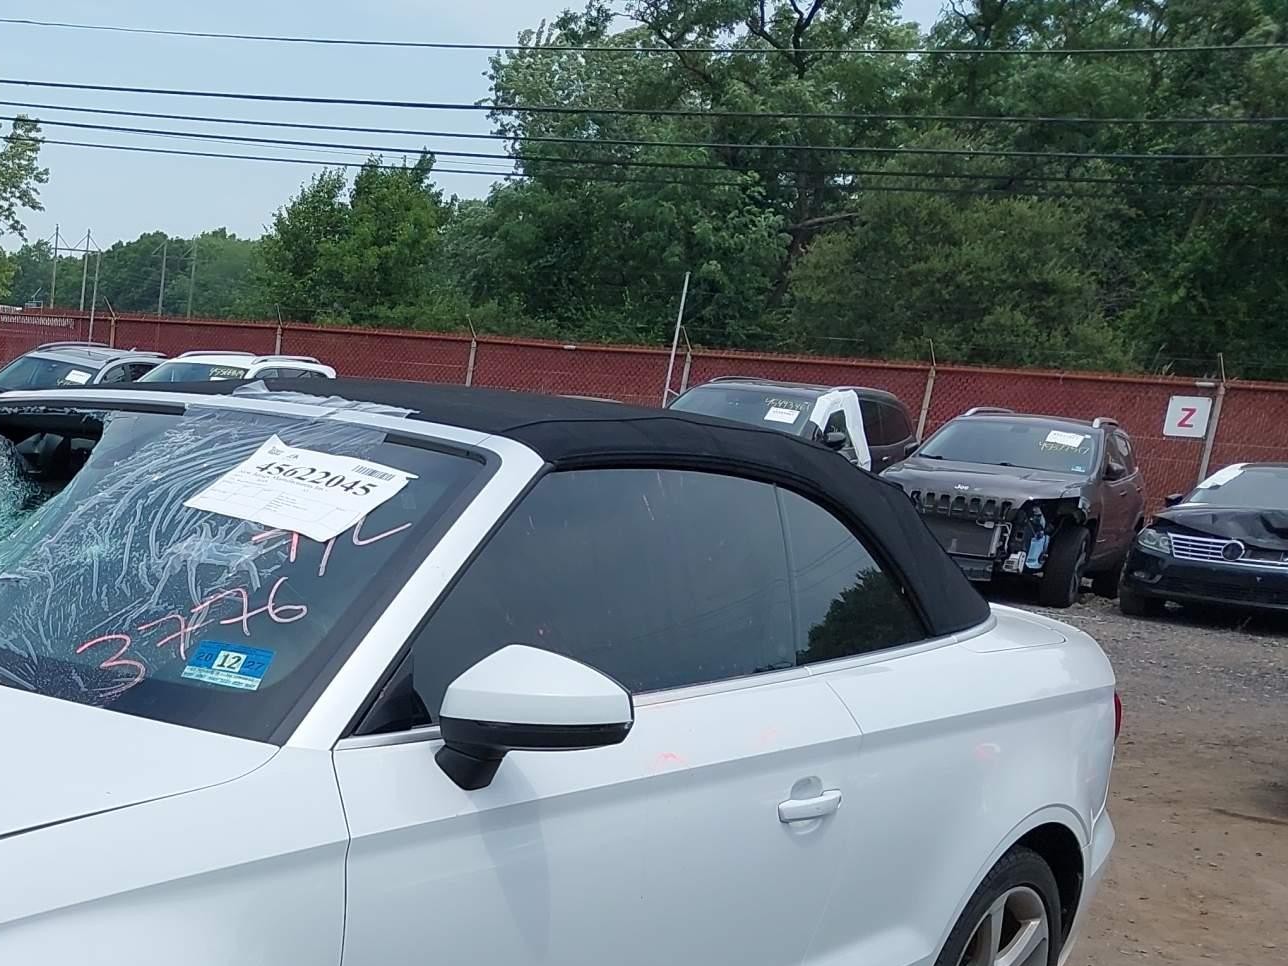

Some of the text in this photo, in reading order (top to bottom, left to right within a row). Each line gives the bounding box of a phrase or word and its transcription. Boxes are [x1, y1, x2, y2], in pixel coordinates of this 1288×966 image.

[1176, 407, 1197, 428] Z
[255, 461, 380, 497] 45622045
[216, 652, 243, 670] 12
[245, 660, 266, 671] 27
